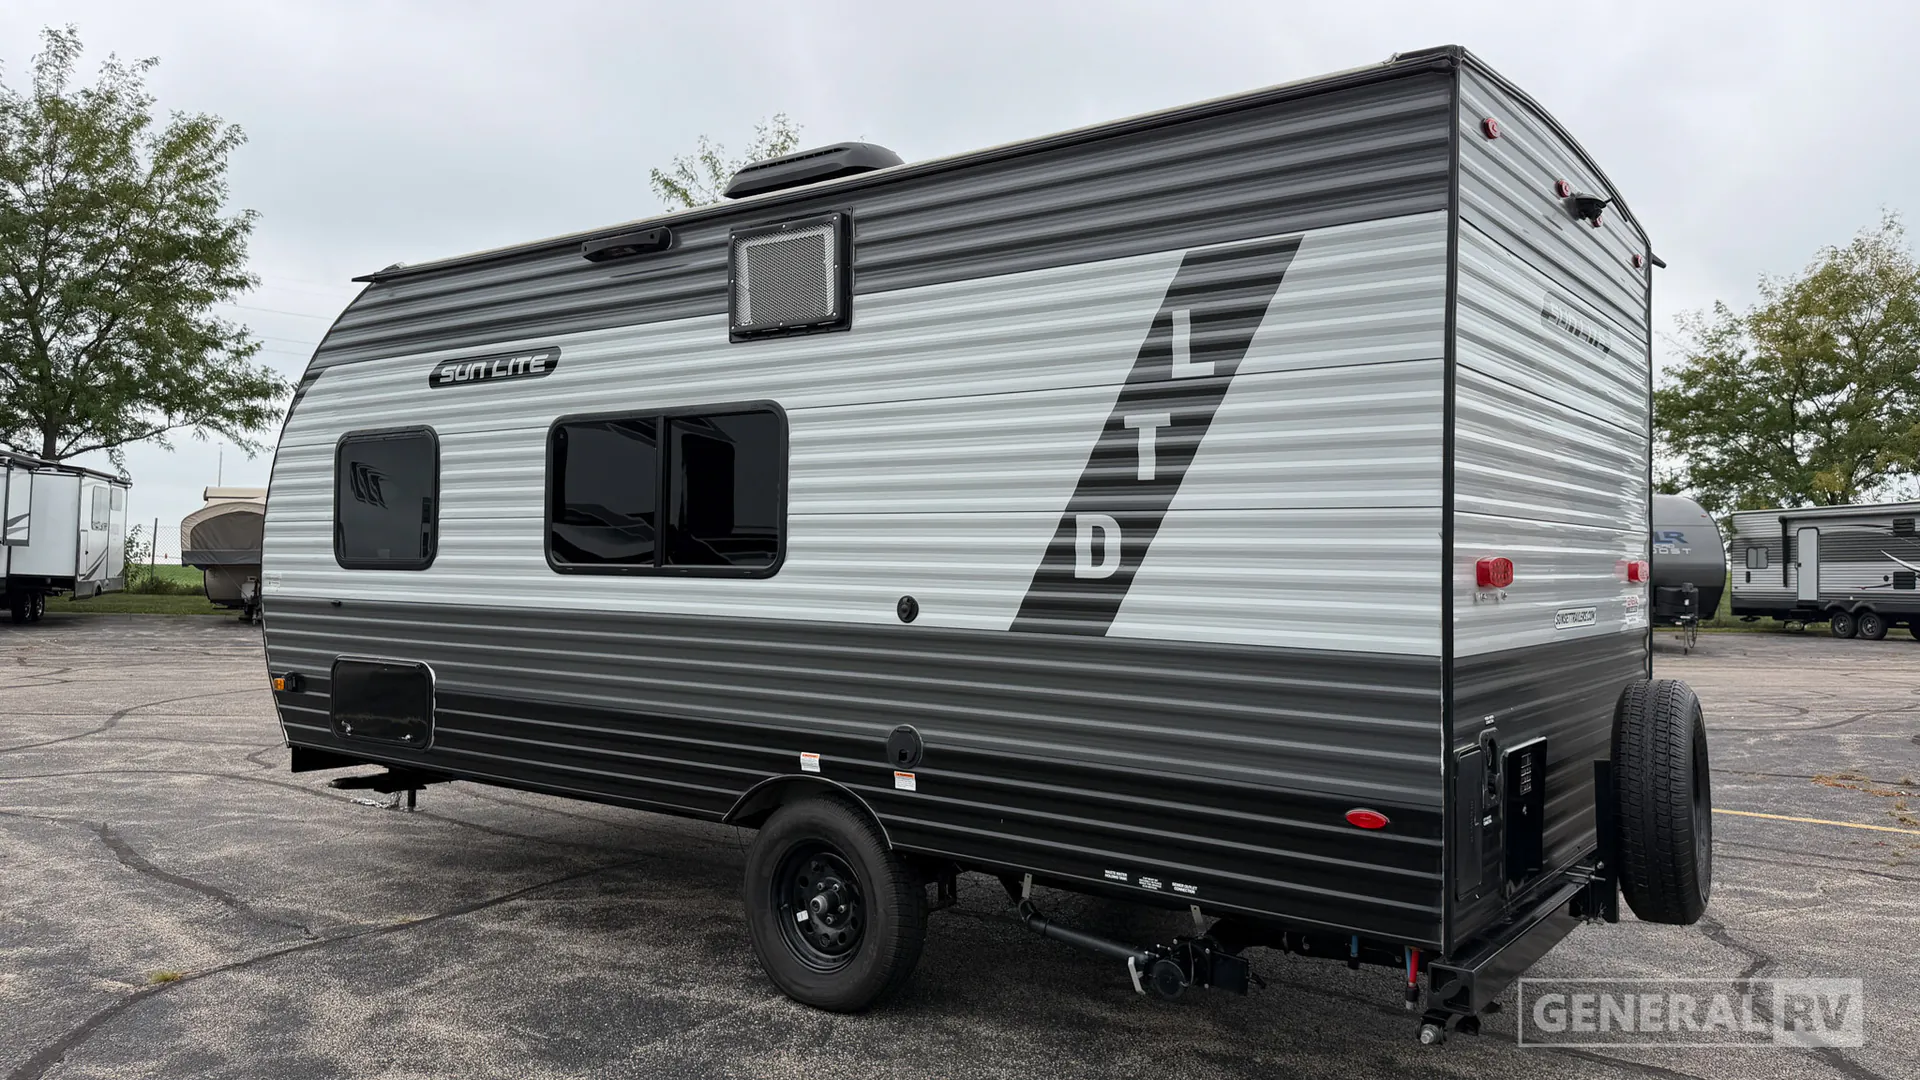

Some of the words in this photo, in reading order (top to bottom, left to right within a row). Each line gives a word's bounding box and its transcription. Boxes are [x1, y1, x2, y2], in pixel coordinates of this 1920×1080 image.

[440, 361, 487, 382] SUN
[491, 354, 549, 377] LITE
[1074, 308, 1215, 579] LTD
[1653, 531, 1689, 544] LR
